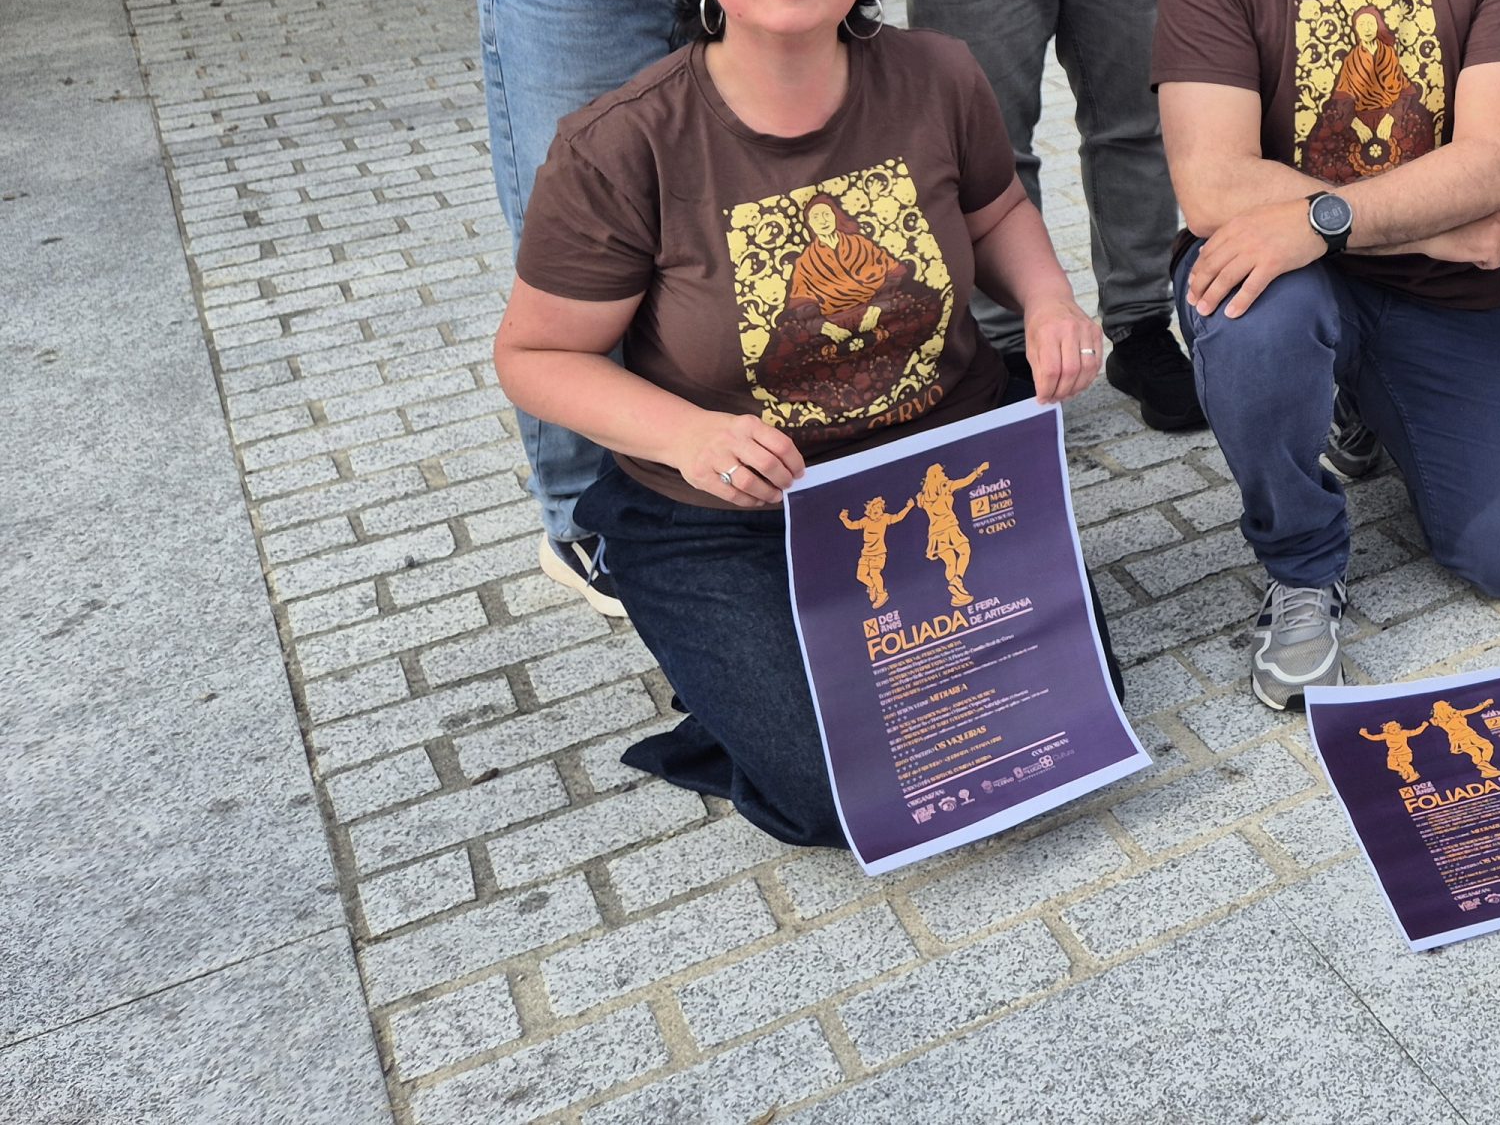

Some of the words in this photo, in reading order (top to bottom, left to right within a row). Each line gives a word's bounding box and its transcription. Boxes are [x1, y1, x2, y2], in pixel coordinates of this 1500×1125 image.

[969, 478, 1010, 499] sábado
[990, 489, 1012, 501] MAIO
[990, 499, 1013, 512] 2026
[986, 518, 1016, 534] CERVO
[967, 605, 975, 615] E
[975, 596, 1001, 612] FEIRA
[969, 614, 983, 626] DE
[866, 610, 969, 662] FOLIADA
